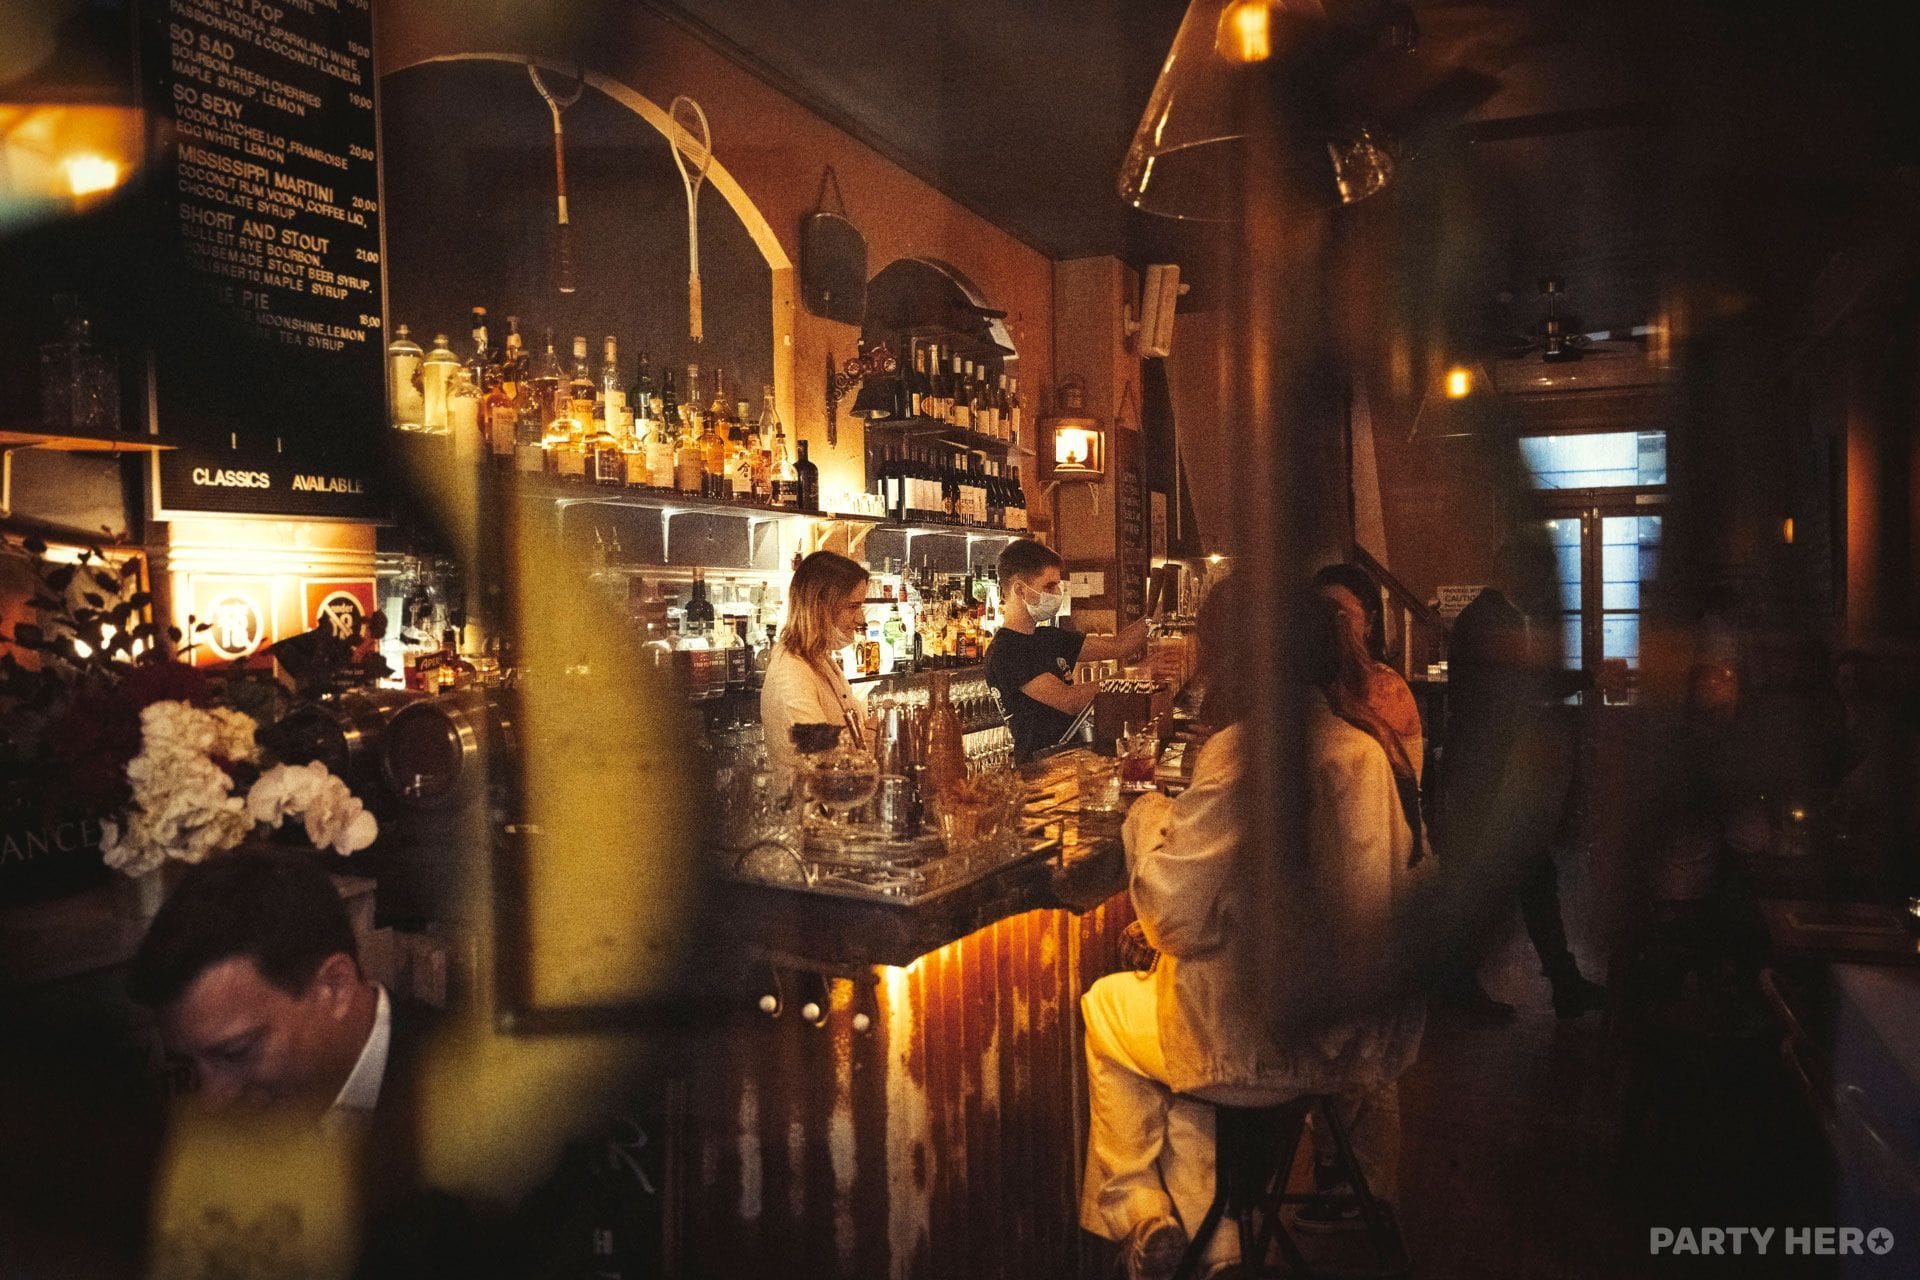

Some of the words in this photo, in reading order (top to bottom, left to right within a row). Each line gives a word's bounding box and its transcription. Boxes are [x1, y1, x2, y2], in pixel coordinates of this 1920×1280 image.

[252, 0, 284, 23] POP
[169, 22, 195, 45] SO
[199, 34, 235, 60] SAD
[169, 0, 253, 42] PASSIONFRUIT
[263, 37, 319, 68] COCONUT
[320, 59, 362, 86] LIQUEUR
[225, 5, 266, 33] VODKA
[269, 25, 328, 59] SPARKLING
[172, 58, 212, 84] MAPLE
[262, 90, 305, 117] LEMON
[172, 82, 198, 104] SO
[201, 93, 243, 119] SEXY
[271, 80, 322, 109] CHERRIES
[176, 119, 202, 138] EGG
[204, 127, 240, 150] WHITE
[244, 140, 285, 164] LEMON
[178, 142, 270, 185] MISSISSIPPI
[274, 171, 334, 204] MARTINI
[178, 163, 237, 190] COCONUT
[178, 179, 254, 211] CHOCOLATE
[257, 200, 297, 221] SYRUP
[179, 202, 236, 232] SHORT
[241, 218, 276, 241] AND
[281, 228, 330, 254] STOUT
[239, 236, 264, 254] RYE
[267, 258, 305, 277] STOUT
[307, 266, 334, 283] BEER
[242, 289, 270, 311] PIE
[311, 282, 348, 301] SYRUP
[280, 329, 303, 346] TEA
[306, 335, 345, 352] SYRUP
[192, 467, 271, 489] CLASSICS
[291, 474, 364, 494] AVAILABLE
